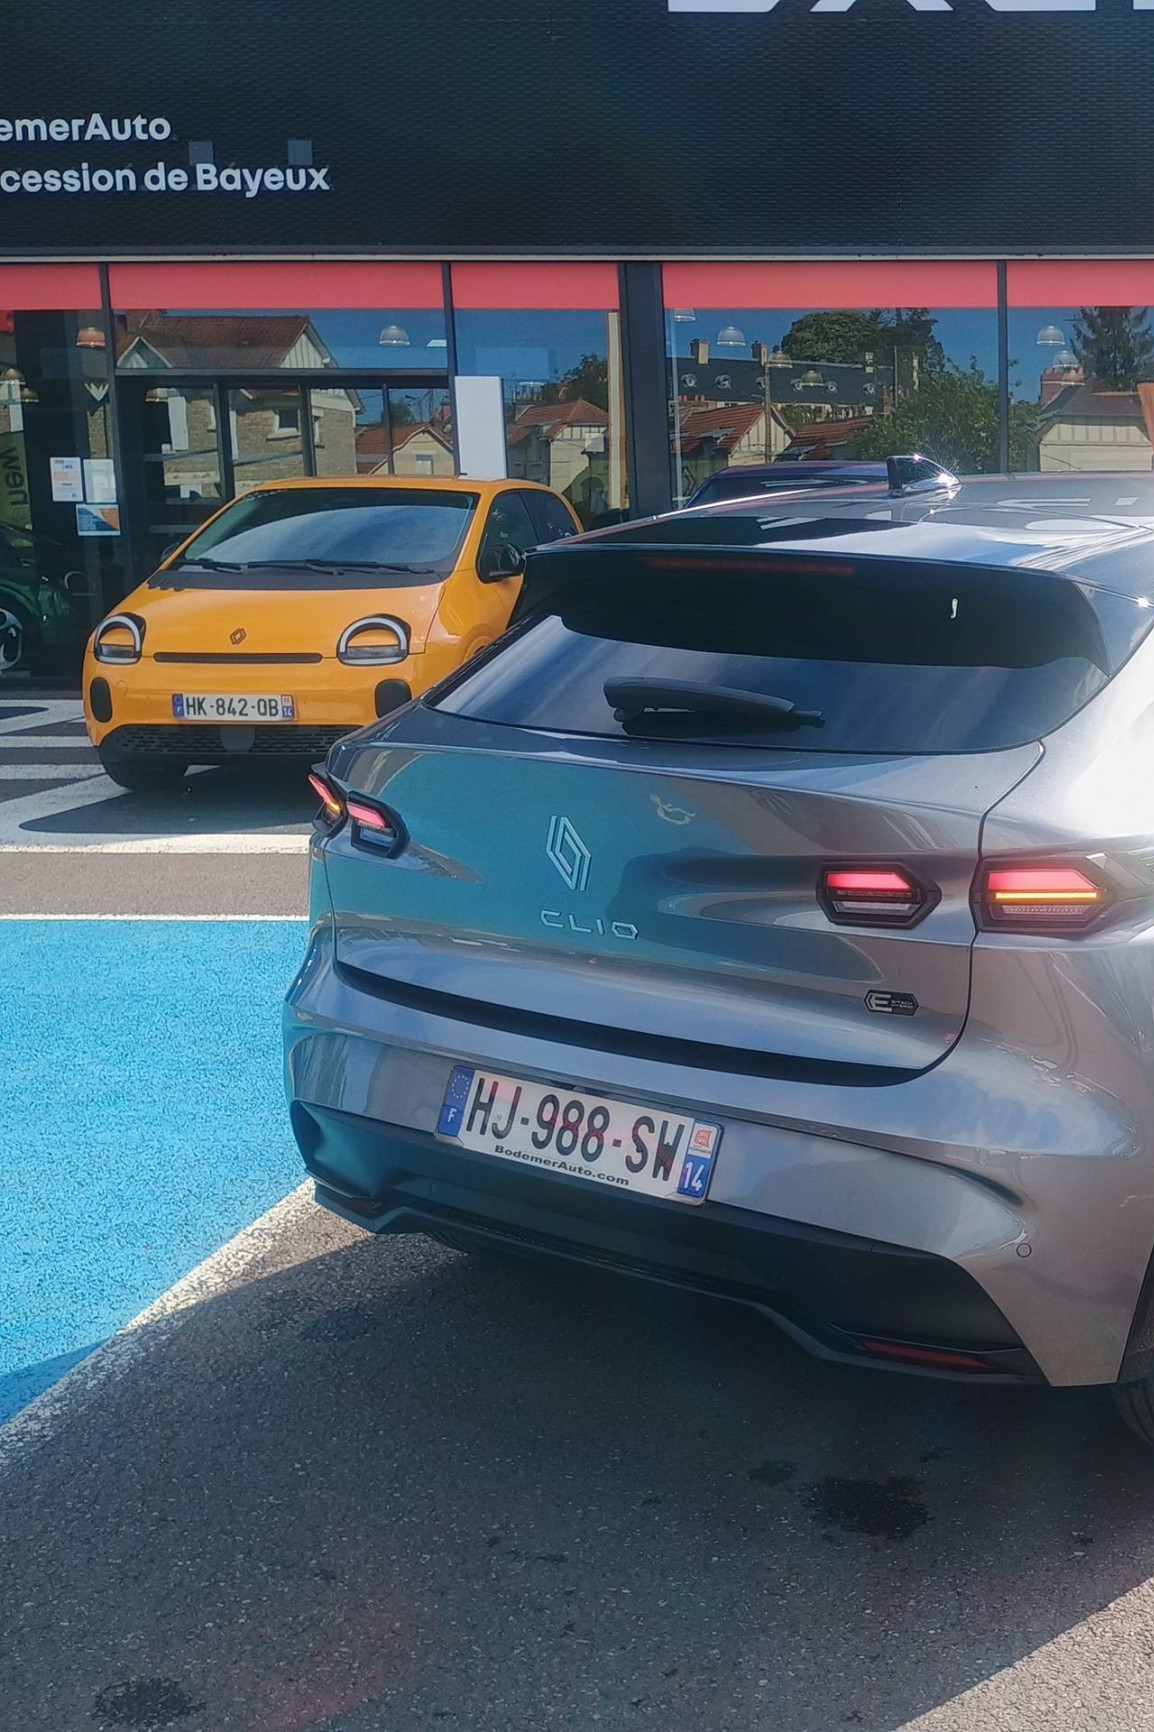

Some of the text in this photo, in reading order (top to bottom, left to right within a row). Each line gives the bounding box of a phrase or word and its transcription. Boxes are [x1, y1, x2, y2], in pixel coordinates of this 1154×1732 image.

[0, 162, 330, 198] cession de Bayeux
[540, 910, 639, 940] CLIO
[447, 1107, 457, 1123] F
[466, 1077, 685, 1182] HJ-988-SW
[494, 1144, 630, 1187] BodemerAuto.com
[684, 1162, 704, 1192] 14
